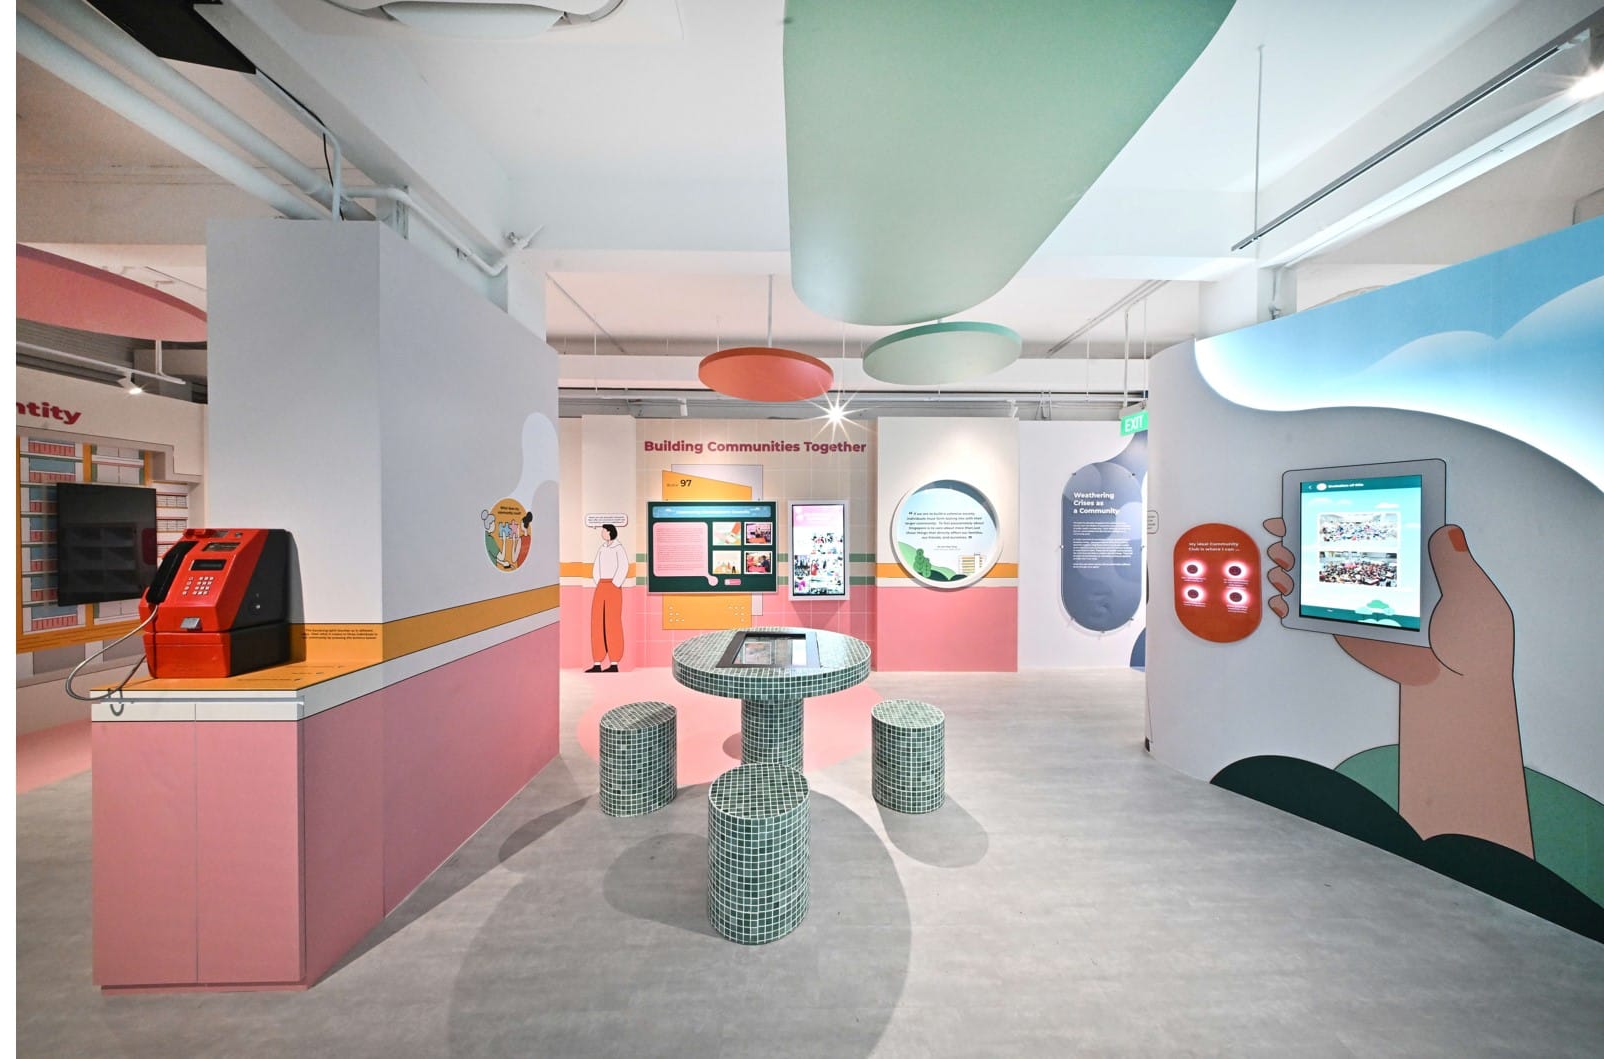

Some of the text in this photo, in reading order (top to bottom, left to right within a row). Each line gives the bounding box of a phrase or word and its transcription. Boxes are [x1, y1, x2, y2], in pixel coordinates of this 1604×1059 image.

[1125, 414, 1143, 432] EXIT
[644, 440, 867, 454] Building Communities Together
[680, 479, 692, 487] 97
[1079, 507, 1120, 515] Community
